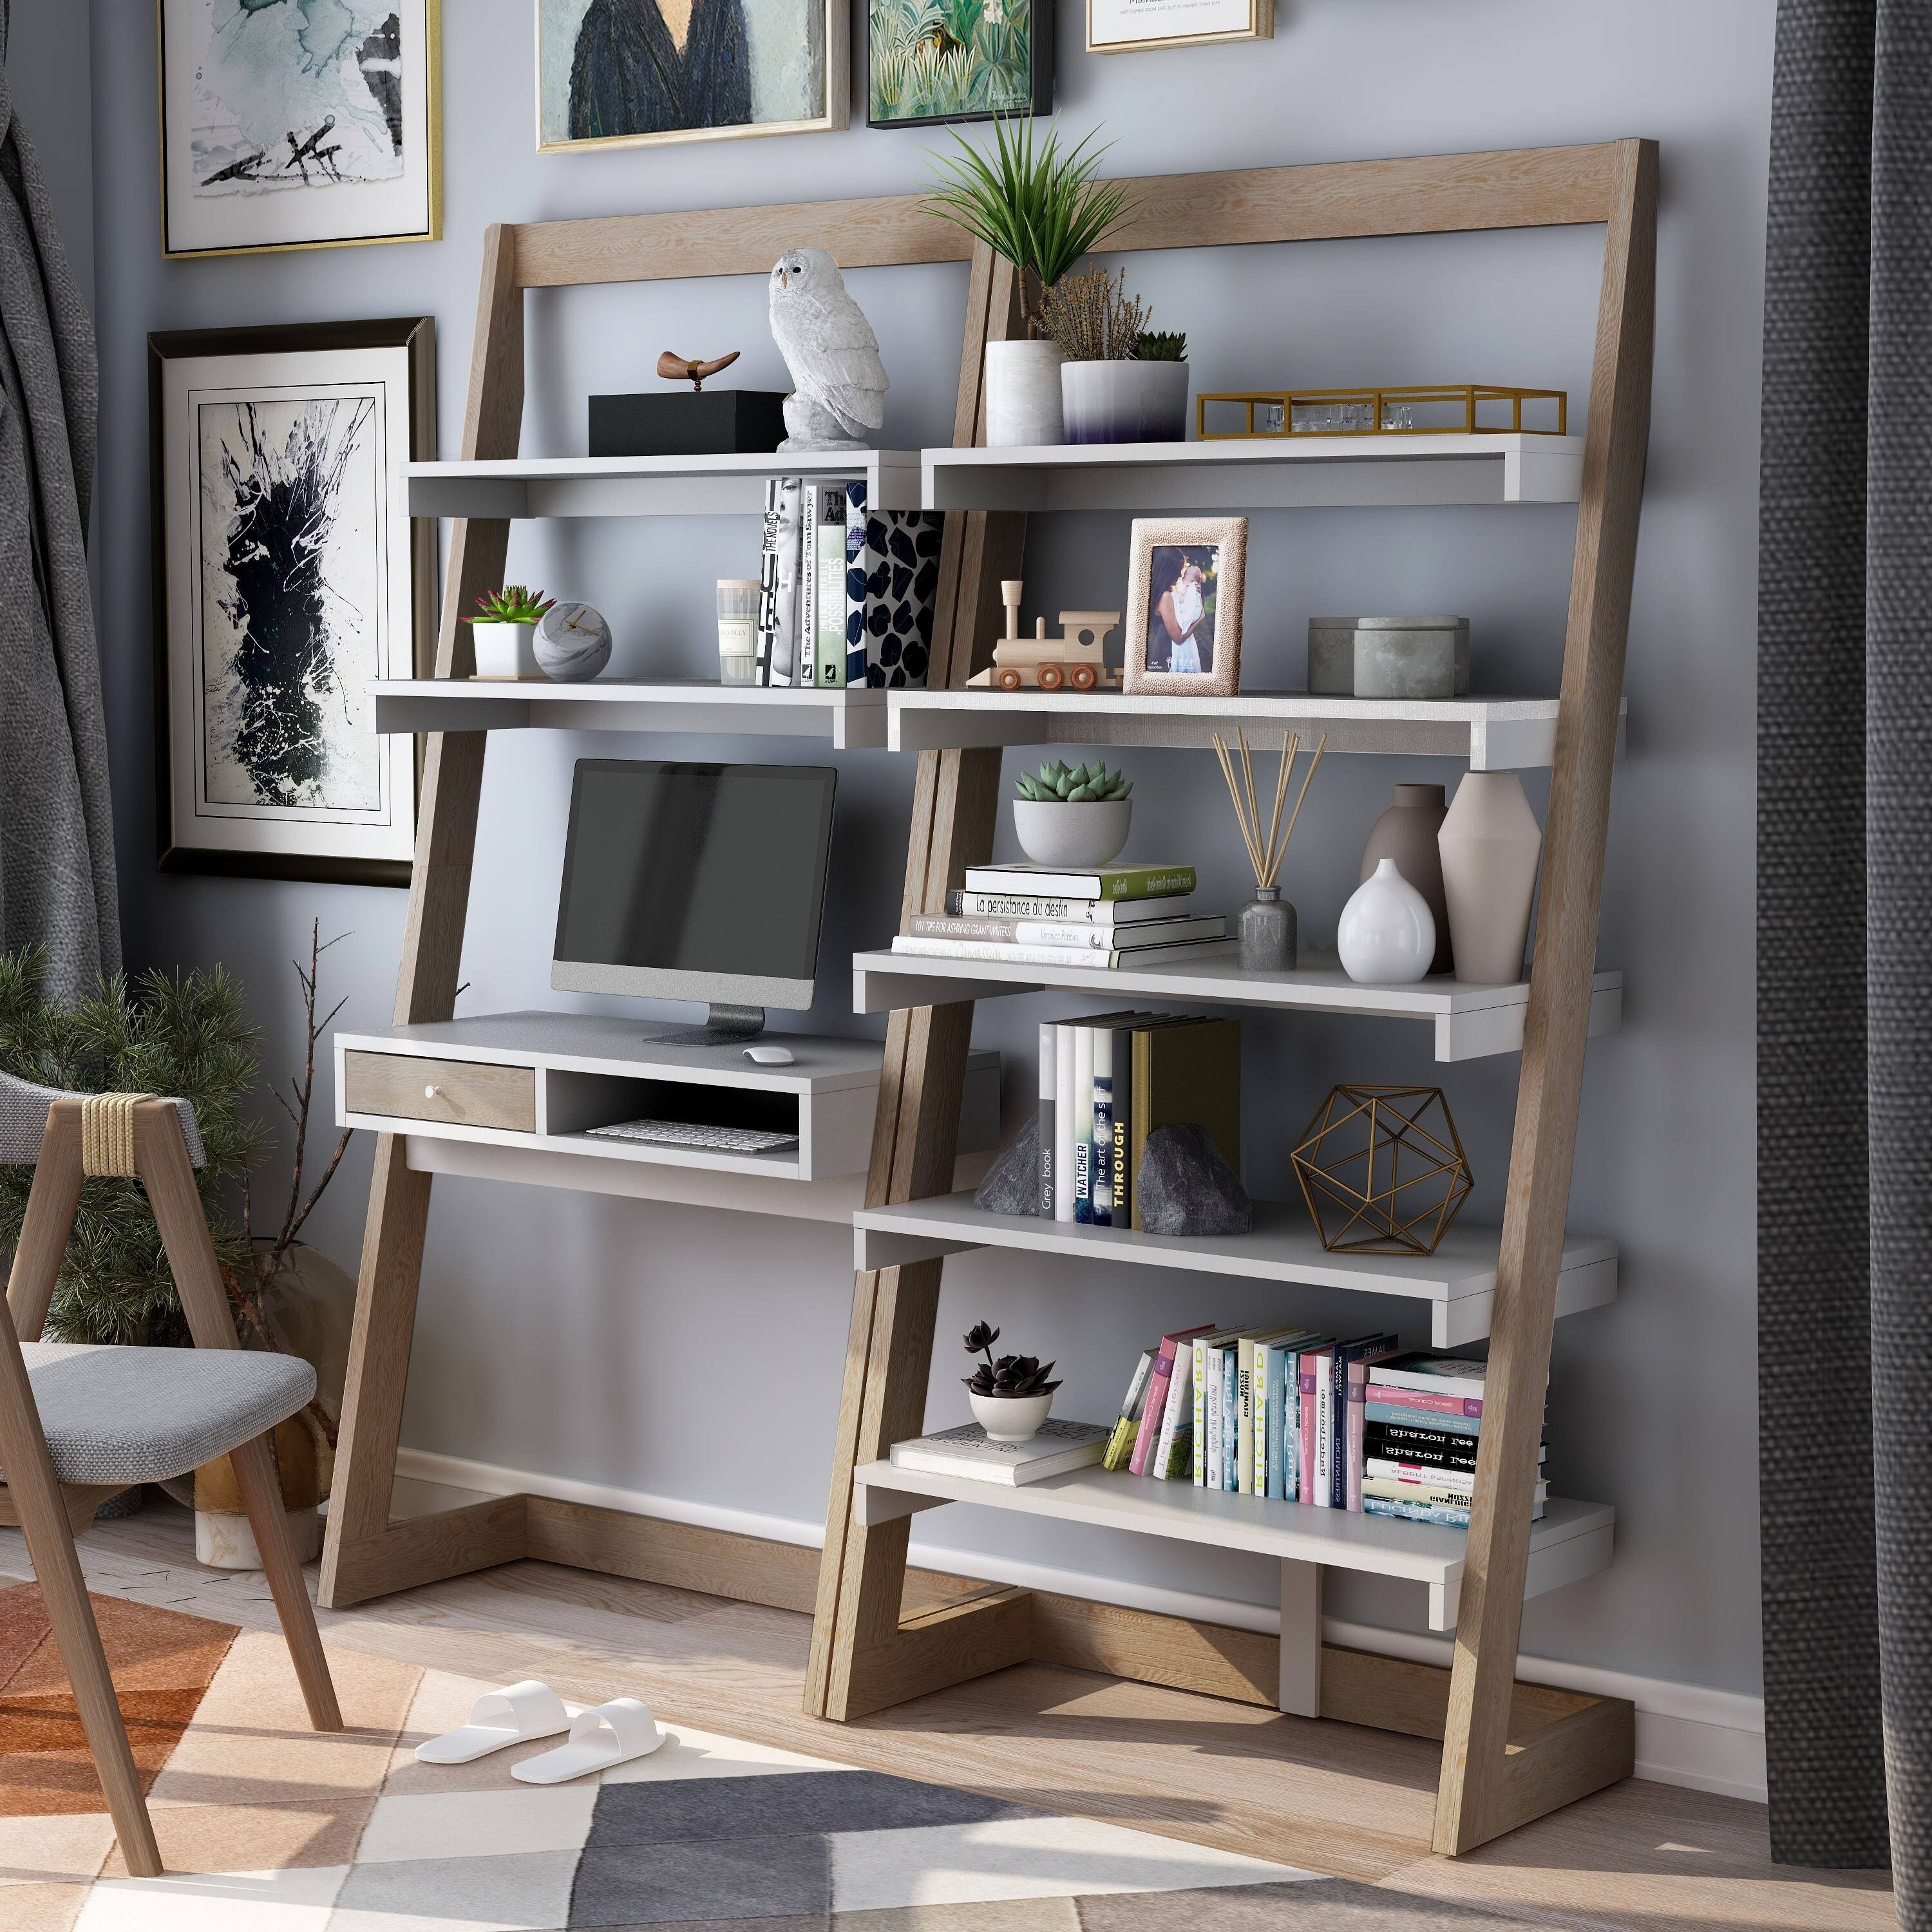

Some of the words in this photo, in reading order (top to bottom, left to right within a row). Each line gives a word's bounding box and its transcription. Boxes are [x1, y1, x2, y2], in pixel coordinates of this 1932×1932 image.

[804, 490, 813, 531] Sawyer
[766, 511, 778, 535] NOVELS
[766, 536, 776, 553] THE
[804, 559, 812, 571] of
[804, 571, 813, 635] Adventures
[819, 558, 828, 632] UNIMAGINABLE
[828, 558, 844, 632] POSSIBILITIES
[976, 894, 985, 913] La
[988, 896, 1030, 918] persistance
[1032, 897, 1043, 916] du
[1046, 898, 1068, 917] destin
[916, 921, 924, 931] 101
[925, 922, 935, 933] TIPS
[936, 922, 946, 933] FOR
[947, 923, 970, 934] ASPIRING
[970, 924, 989, 935] GRANT
[990, 925, 1011, 937] WRITERS
[1041, 929, 1061, 940] Veronica
[1096, 1086, 1106, 1110] surf
[1096, 1111, 1106, 1130] the
[1096, 1132, 1106, 1146] of
[1042, 1148, 1051, 1177] book
[1097, 1148, 1106, 1165] art
[1113, 1122, 1124, 1208] THROUGH
[1077, 1144, 1087, 1196] WATCHER
[1096, 1167, 1106, 1190] The
[1042, 1183, 1053, 1209] Grey
